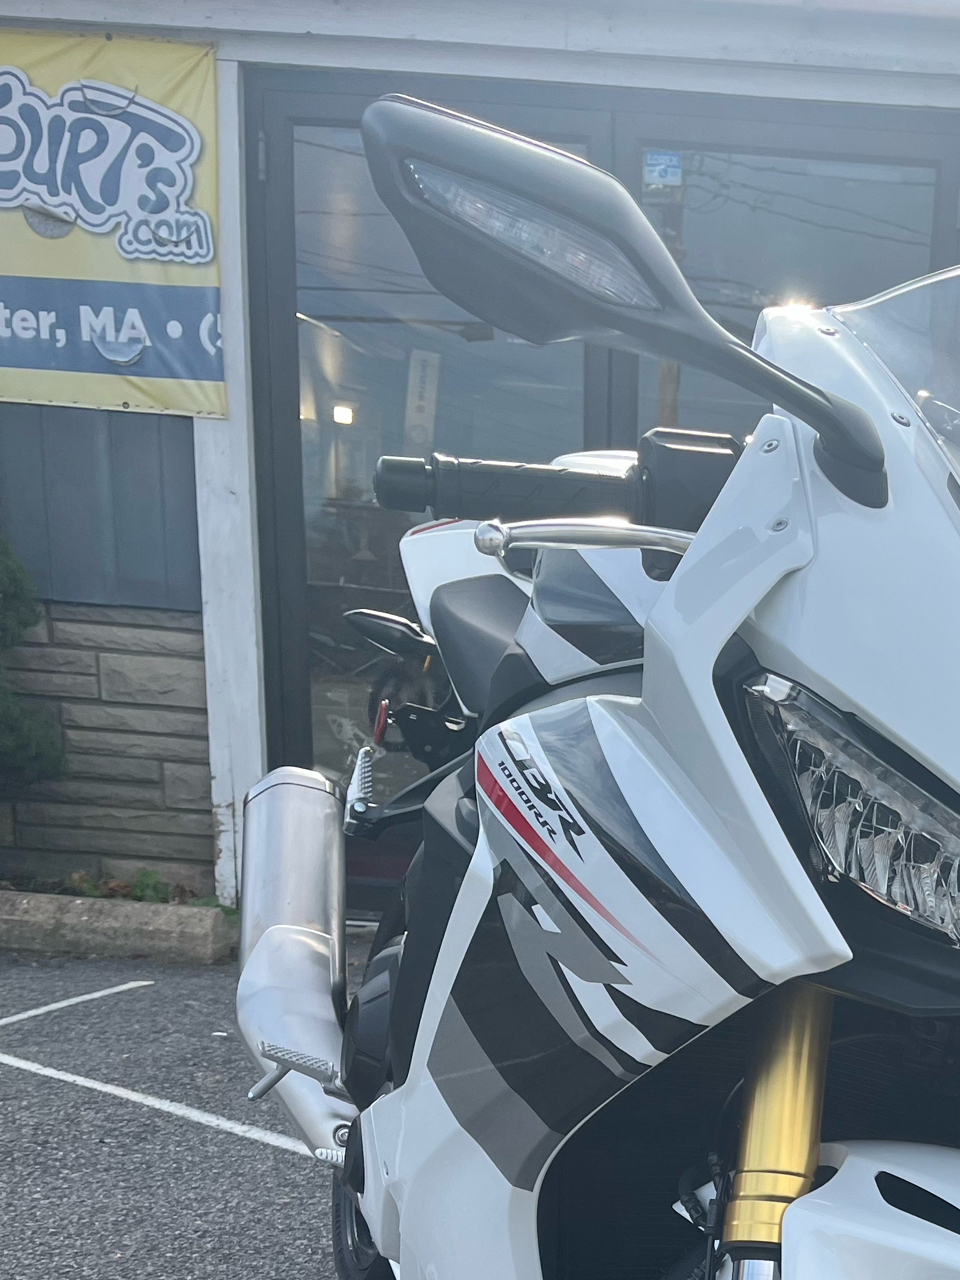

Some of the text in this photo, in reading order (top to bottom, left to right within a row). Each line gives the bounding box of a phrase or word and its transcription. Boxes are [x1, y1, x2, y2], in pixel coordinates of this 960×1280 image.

[126, 218, 204, 250] .com
[79, 305, 153, 346] MA
[498, 729, 586, 863] CBR
[498, 761, 557, 844] 1000RR
